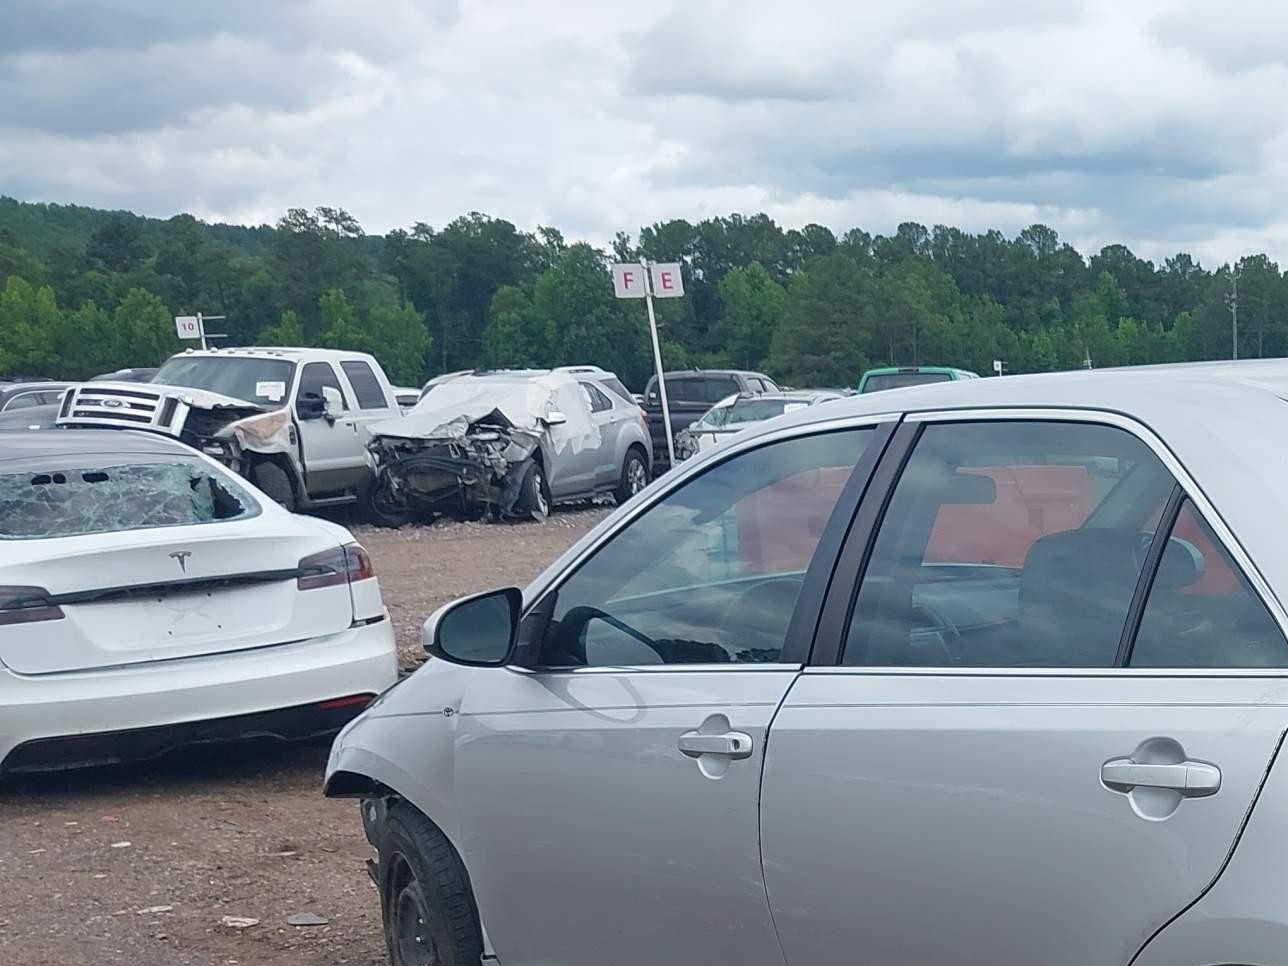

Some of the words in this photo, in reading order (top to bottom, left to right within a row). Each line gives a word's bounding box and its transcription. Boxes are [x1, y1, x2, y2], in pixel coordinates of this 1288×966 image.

[623, 272, 634, 289] F
[661, 272, 674, 289] E
[181, 322, 195, 331] 10
